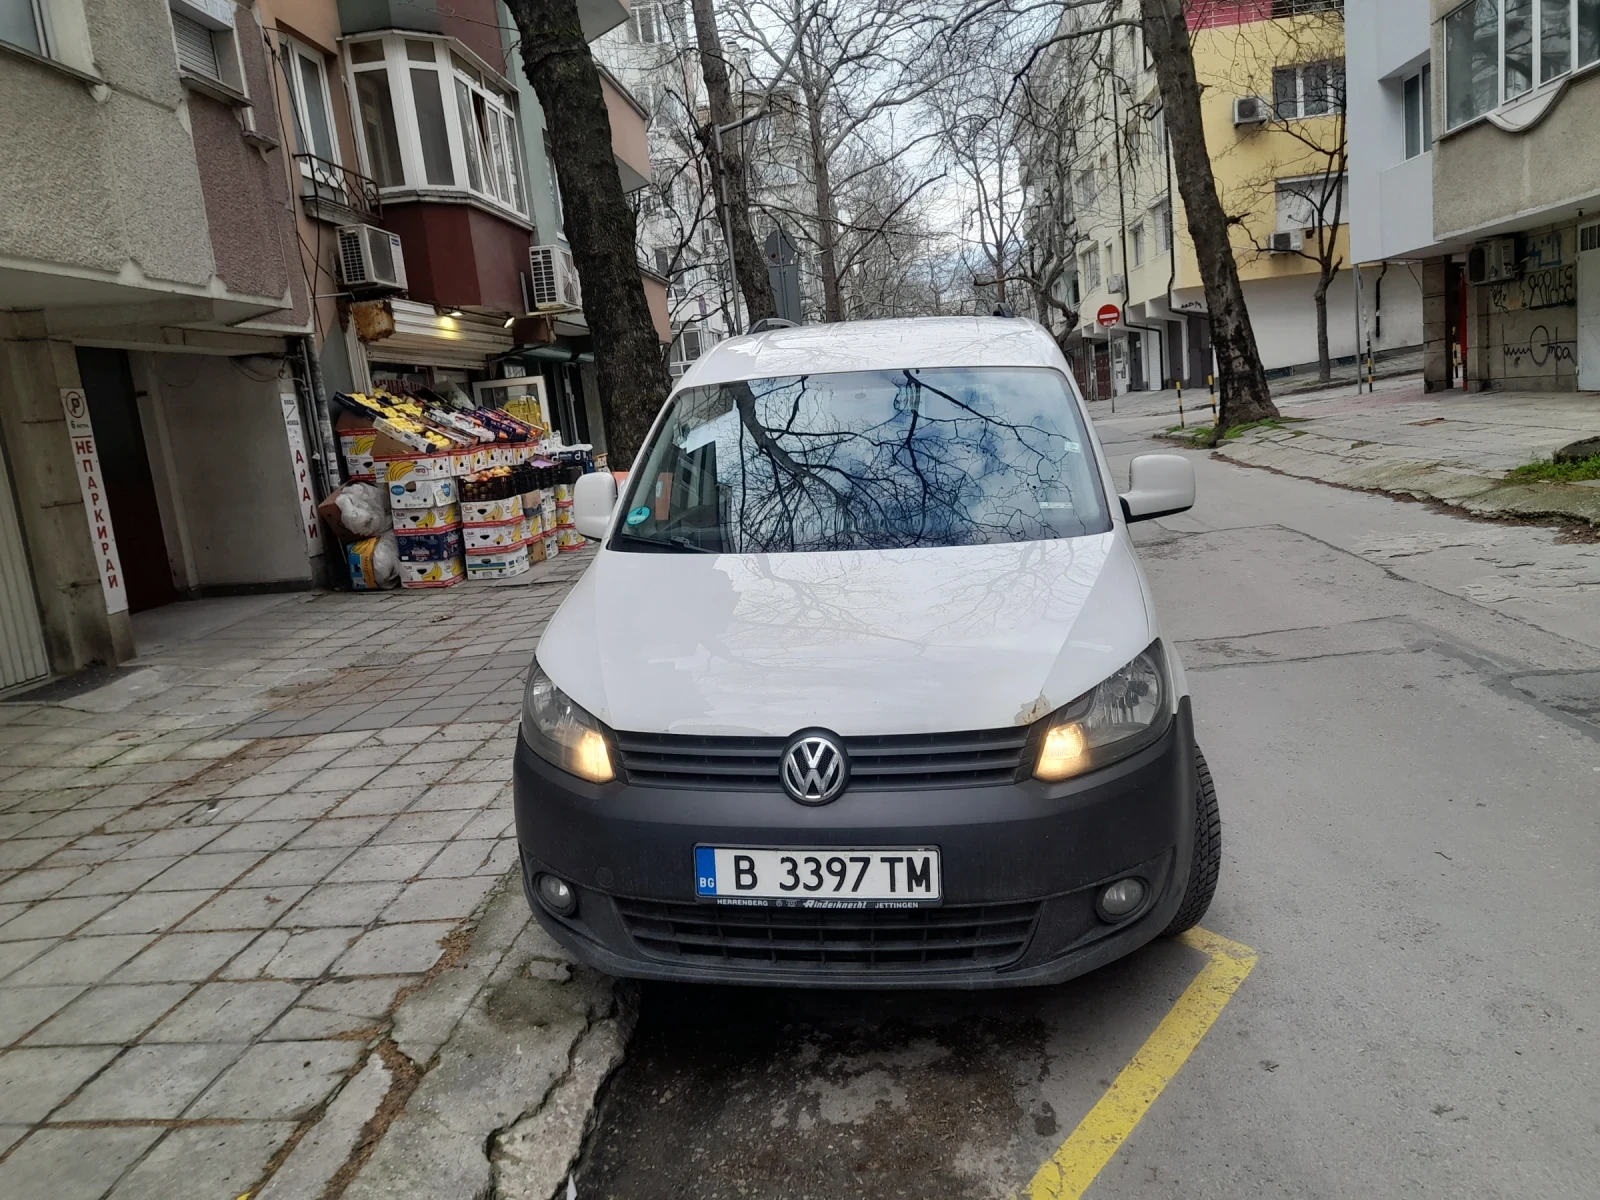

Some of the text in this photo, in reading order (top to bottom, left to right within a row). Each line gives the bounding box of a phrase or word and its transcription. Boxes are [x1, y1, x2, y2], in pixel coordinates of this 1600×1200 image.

[75, 441, 93, 455] НЕ
[733, 854, 931, 893] B 3397 TM
[699, 877, 715, 888] BG
[717, 899, 768, 907] HERRENBERG
[874, 901, 919, 909] JETTINGEN
